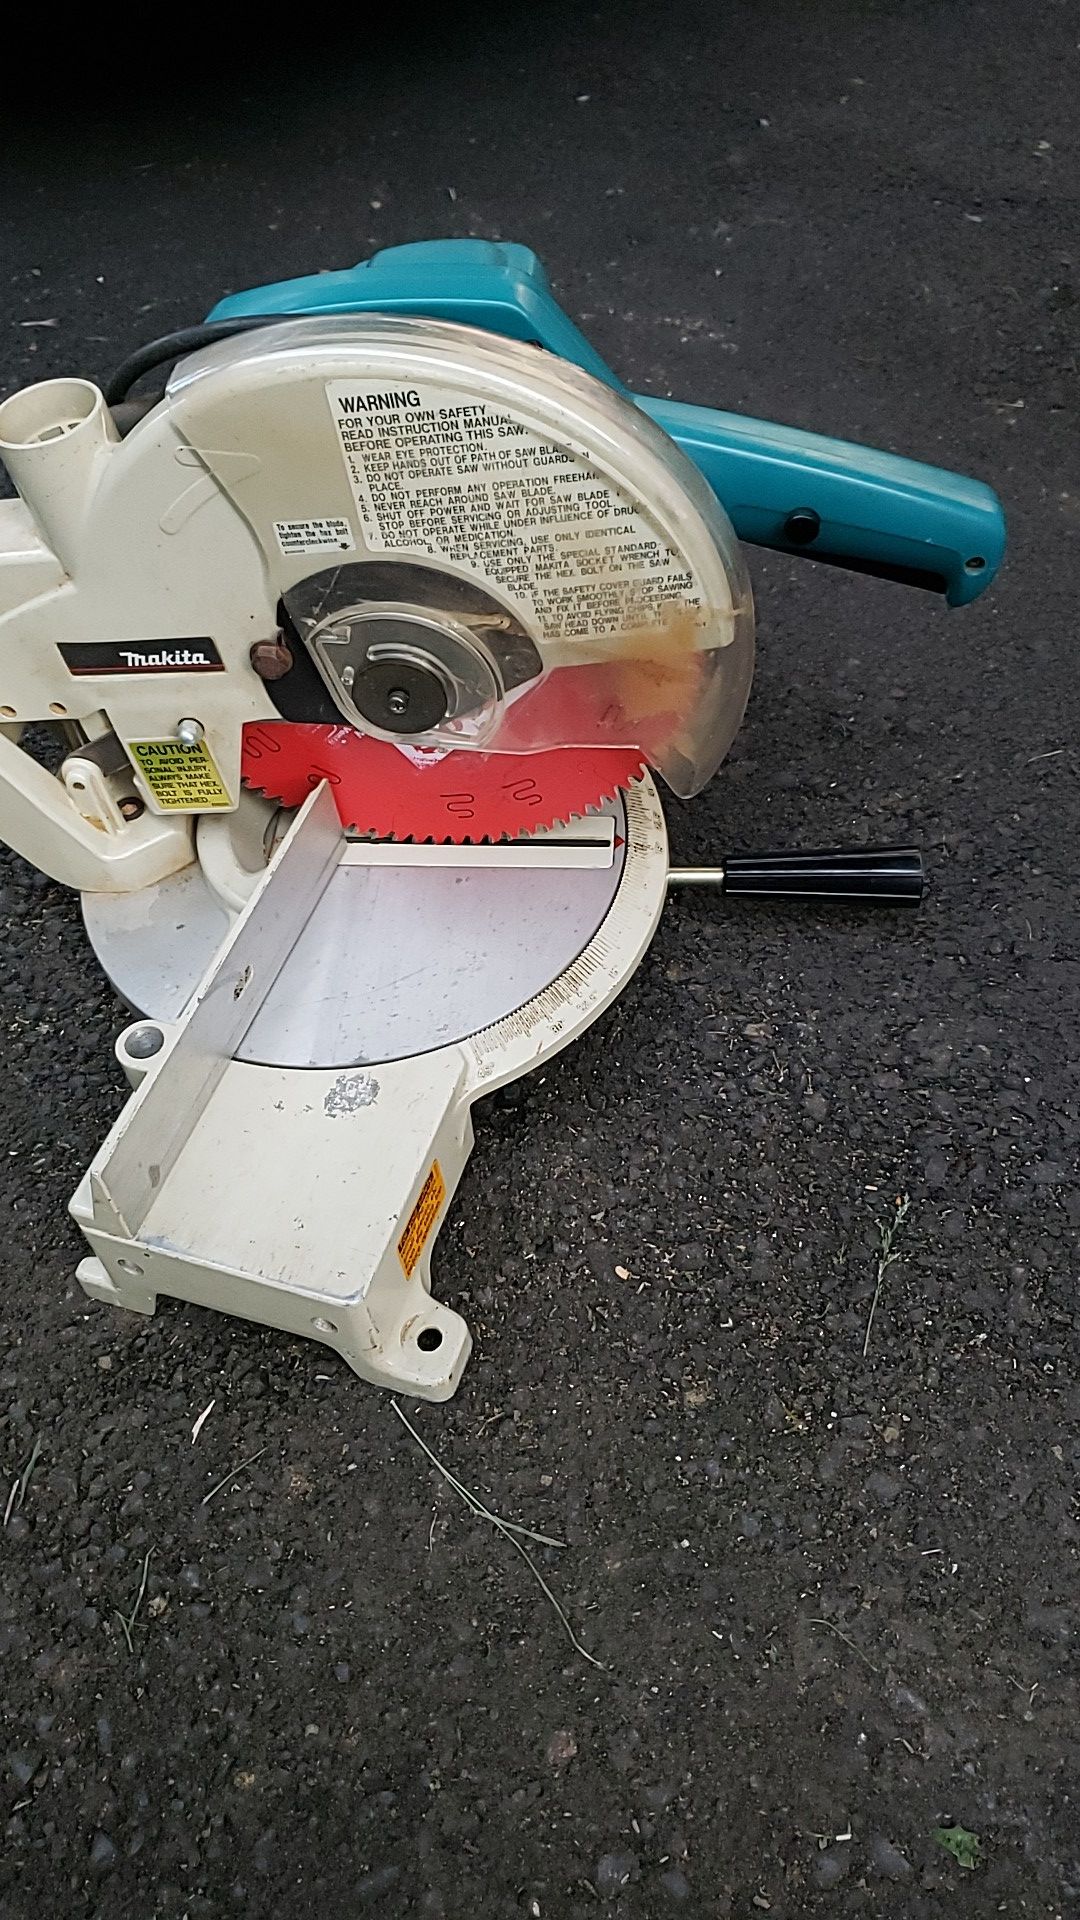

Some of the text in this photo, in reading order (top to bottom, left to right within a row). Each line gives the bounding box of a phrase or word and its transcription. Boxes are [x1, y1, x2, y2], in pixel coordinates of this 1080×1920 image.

[338, 390, 421, 414] WARNING
[338, 404, 486, 429] FOR YOUR OWN SAFETY
[341, 428, 374, 440] READ
[378, 420, 459, 438] INSTRUCTION
[344, 425, 528, 452] BEFORE OPERATING THIS SAW.
[350, 466, 360, 474] 2.
[364, 462, 390, 472] KEEP
[392, 458, 426, 470] HANDS
[430, 456, 451, 466] OUT
[454, 454, 470, 464] OF
[471, 452, 496, 462] PATH
[498, 450, 512, 460] OF
[515, 447, 536, 458] SAW
[540, 443, 572, 456] BLA
[362, 452, 391, 462] WEAR
[396, 449, 414, 460] EYE
[420, 442, 488, 457] PROTECTION.
[354, 476, 363, 484] 3.
[366, 473, 381, 482] DO
[384, 470, 404, 480] NOT
[408, 466, 453, 480] OPERATE
[457, 464, 479, 474] SAW
[482, 458, 528, 472] WITHOUT
[369, 482, 404, 492] PLACE.
[372, 493, 386, 502] DO
[390, 490, 410, 500] NOT
[416, 486, 462, 498] PERFORM
[467, 483, 486, 494] ANY
[492, 477, 549, 490] OPERATION
[554, 472, 600, 484] FREEHA
[361, 486, 556, 513] 5. NEVER REACH AROUND SAW BLADE.
[363, 514, 372, 522] 6.
[376, 511, 402, 522] SHUT
[407, 510, 426, 518] OFF
[430, 505, 466, 516] POWER
[471, 502, 490, 512] AND
[496, 500, 520, 510] WAIT
[526, 497, 545, 507] FOR
[550, 494, 572, 504] SAW
[578, 490, 610, 502] BLADE
[379, 499, 616, 531] STOP BEFORE SERVICING OR ADJUSTING TOOL.
[382, 531, 396, 540] DO
[399, 529, 418, 538] NOT
[422, 524, 466, 536] OPERATE
[470, 521, 500, 532] WHILE
[504, 517, 537, 529] UNDER
[540, 511, 593, 525] INFLUENCE
[597, 508, 610, 519] OF
[436, 536, 450, 545] OR
[454, 530, 516, 543] MEDICATION.
[440, 543, 469, 553] WHEN
[530, 534, 550, 545] USE
[554, 532, 580, 542] ONLY
[585, 525, 636, 538] IDENTICAL
[450, 548, 518, 561] REPLACEMENT
[484, 558, 502, 568] USE
[507, 555, 532, 566] ONLY
[538, 552, 556, 562] THE
[560, 548, 600, 560] SPECIAL
[485, 565, 529, 576] EQUIPPED
[535, 560, 570, 572] MAKITA
[576, 556, 614, 568] SOCKET
[620, 550, 660, 562] WRENCH
[496, 574, 530, 584] SECURE
[535, 572, 552, 580] THE
[580, 566, 604, 576] BOLT
[608, 563, 622, 572] ON
[628, 560, 646, 570] THE
[649, 558, 670, 568] SAW
[531, 590, 539, 599] IF
[544, 588, 559, 597] THE
[562, 584, 596, 596] SAFETY
[600, 580, 630, 591] COVER
[668, 571, 692, 583] FAILS
[532, 598, 544, 606] TO
[547, 596, 573, 605] WORK
[630, 587, 654, 596] SOP
[658, 582, 693, 593] SAWING
[535, 606, 552, 615] AND
[556, 604, 570, 612] FIX
[574, 602, 581, 611] IT
[586, 599, 619, 610] BEFORE
[552, 613, 564, 622] TO
[566, 611, 592, 620] AVOID
[594, 606, 624, 616] FLYING
[543, 630, 561, 639] HAS
[564, 628, 589, 637] COME
[594, 626, 606, 634] TO
[610, 624, 616, 632] A
[544, 622, 562, 631] SAW
[564, 620, 589, 629] HEAD
[592, 616, 619, 626] DOWN
[136, 743, 203, 756] CAUTION
[144, 766, 174, 774] SONAL
[148, 774, 182, 782] ALWAYS
